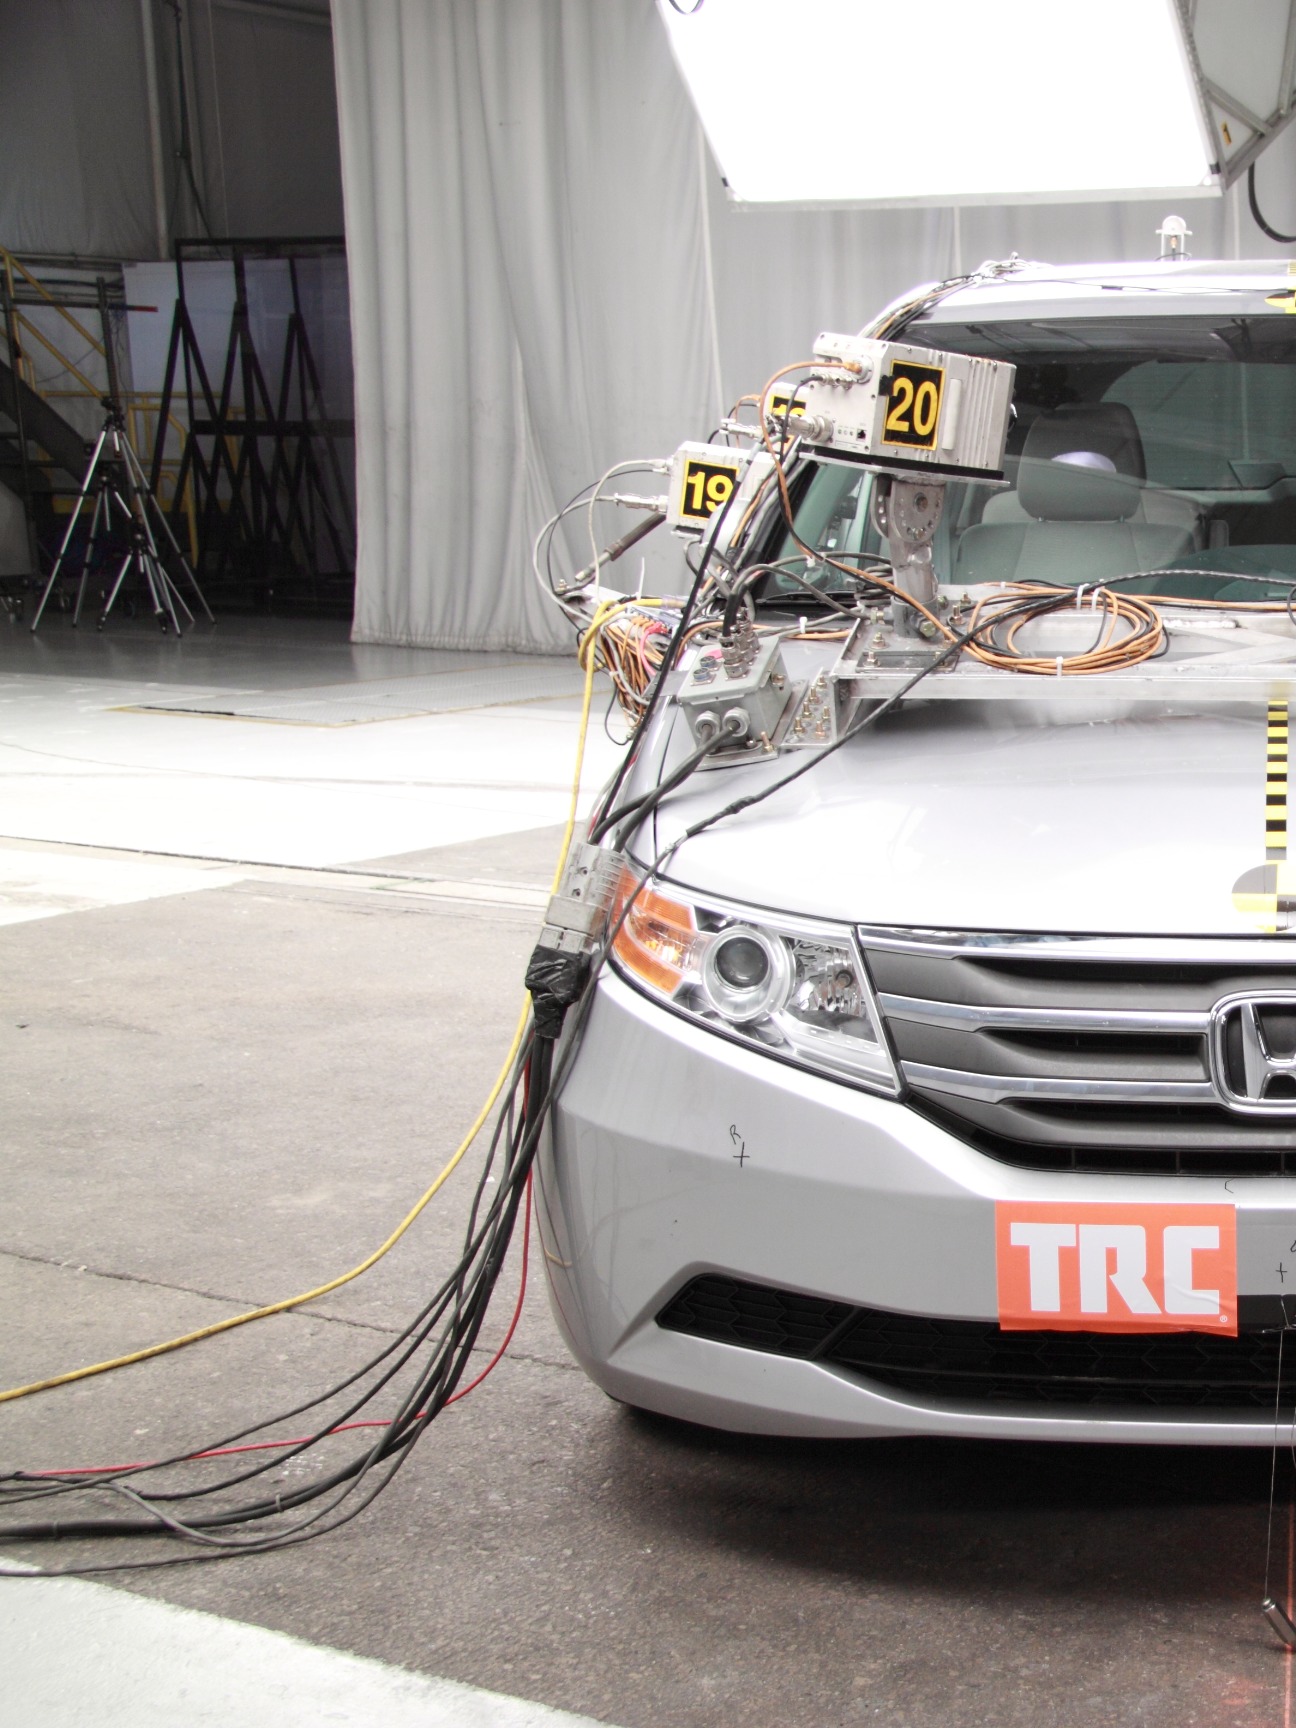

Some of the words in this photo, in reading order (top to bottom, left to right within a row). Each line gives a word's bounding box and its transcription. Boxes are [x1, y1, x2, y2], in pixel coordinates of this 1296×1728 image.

[886, 377, 938, 436] 20
[687, 471, 733, 513] 19
[1010, 1222, 1220, 1316] TRC
